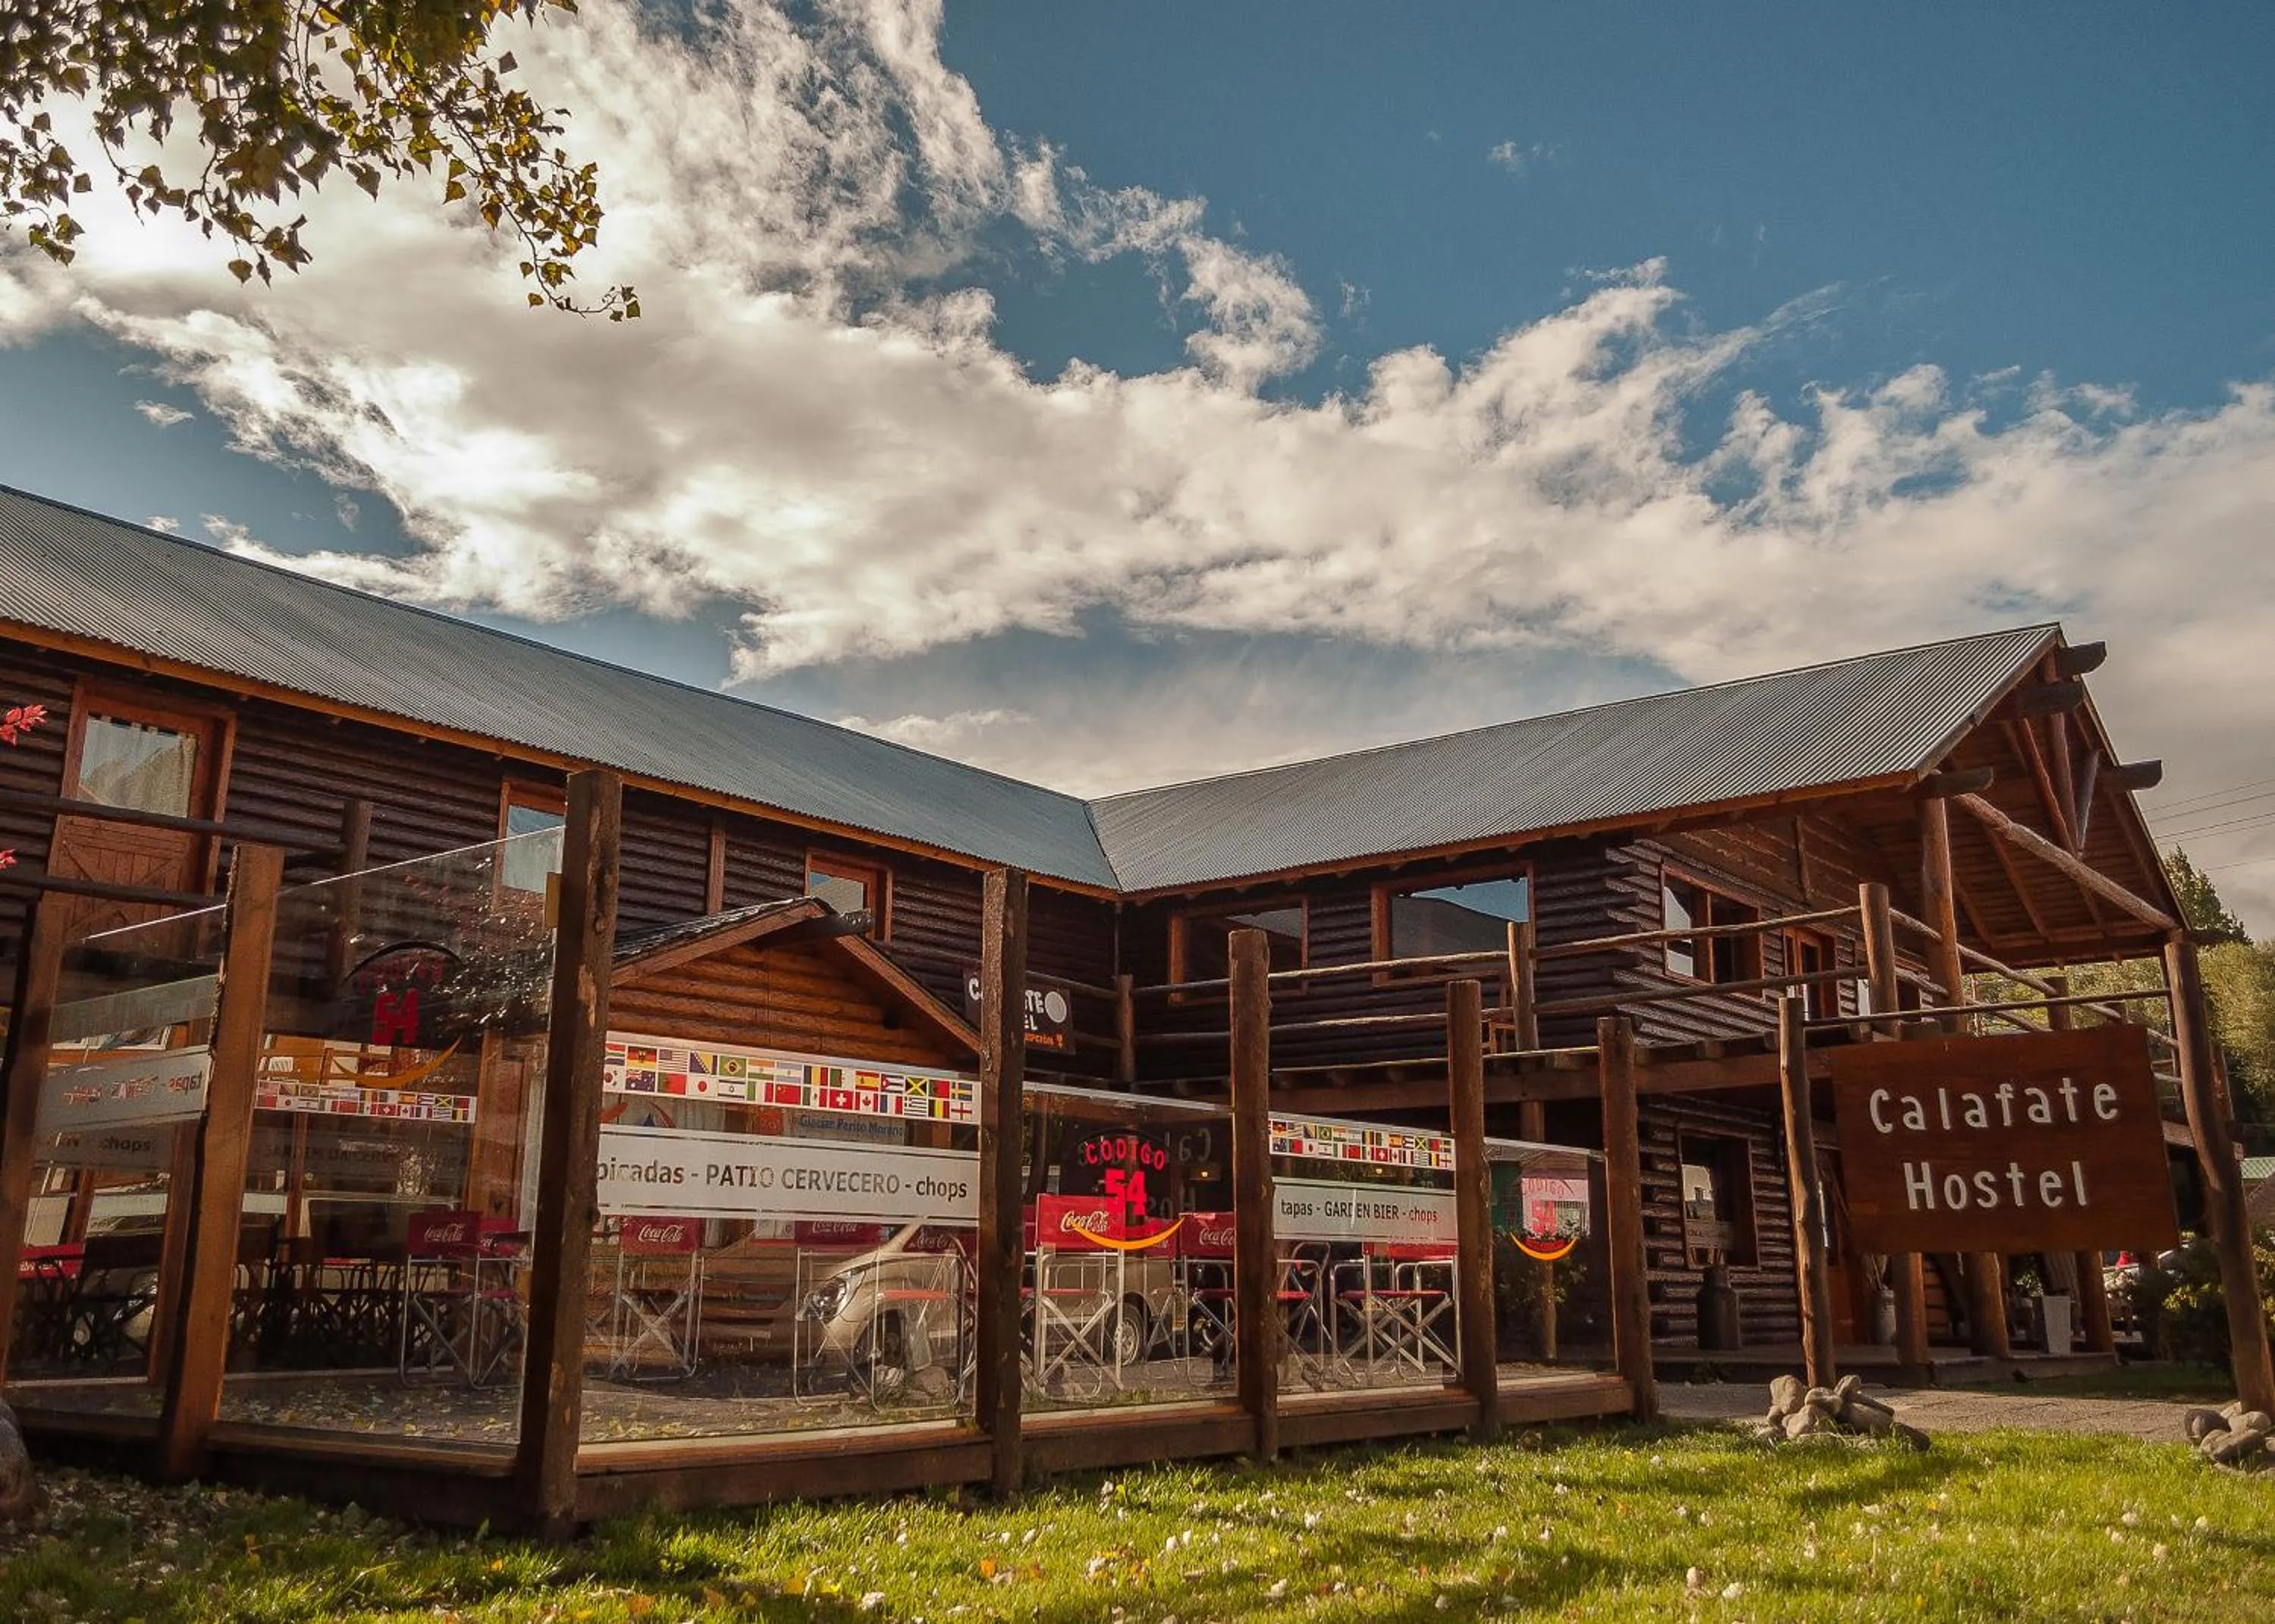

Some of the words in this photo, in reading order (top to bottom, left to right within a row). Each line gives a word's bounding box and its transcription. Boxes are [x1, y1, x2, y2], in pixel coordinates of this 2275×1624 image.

[1869, 1077, 2120, 1134] Calafate
[1085, 1139, 1165, 1171] CODIGO
[706, 1164, 774, 1187] PATIO
[781, 1168, 899, 1194] CERVECERO
[915, 1177, 968, 1201] chops
[1105, 1168, 1147, 1215] 54
[1903, 1160, 2088, 1211] Hostel
[1281, 1199, 1313, 1219] tapas
[1324, 1201, 1370, 1219] GARDEN
[1373, 1203, 1400, 1221] BIER
[1409, 1207, 1438, 1225] chops
[639, 1224, 684, 1243] Coca-Cola
